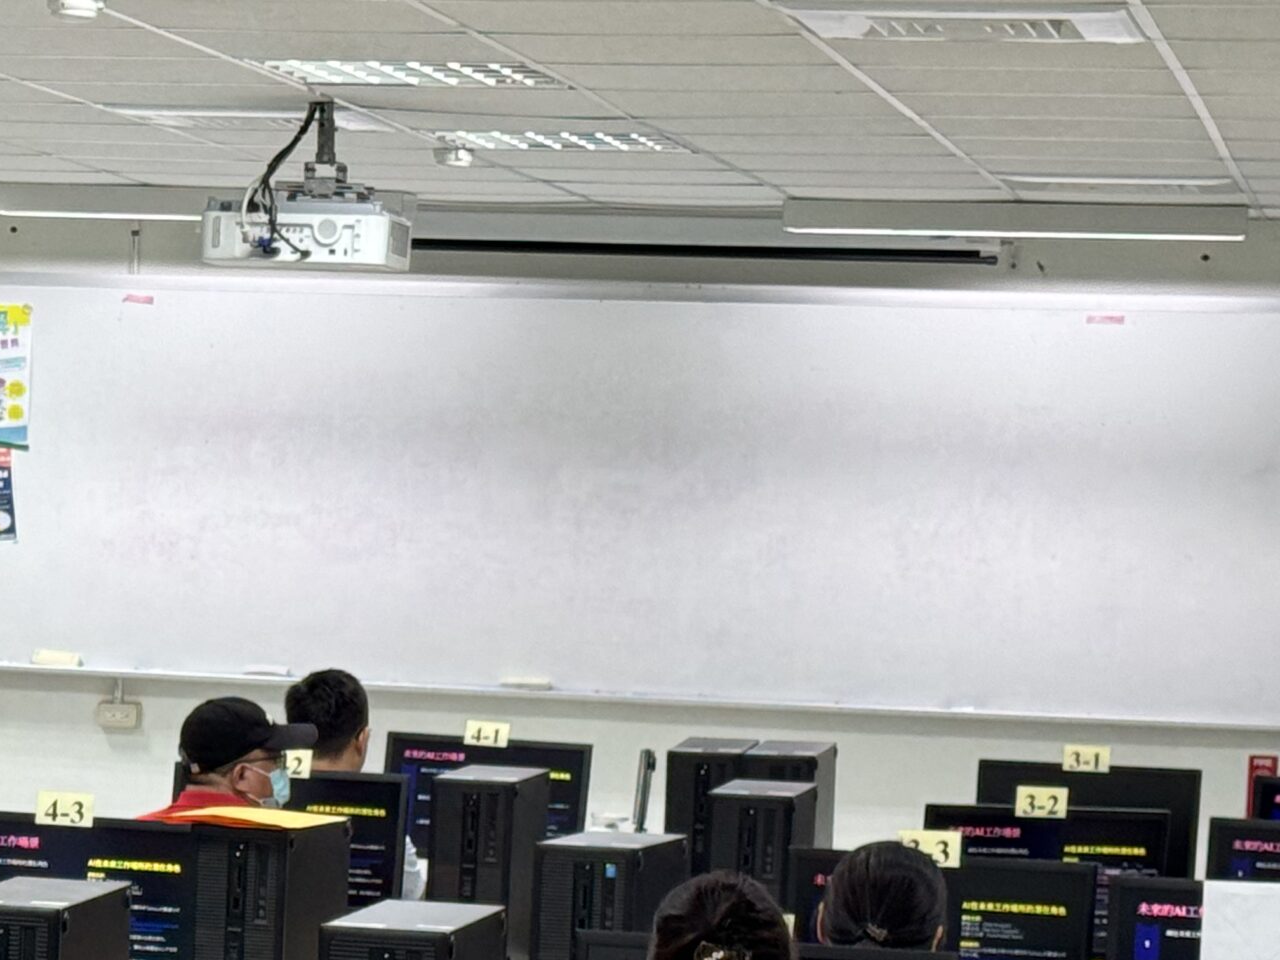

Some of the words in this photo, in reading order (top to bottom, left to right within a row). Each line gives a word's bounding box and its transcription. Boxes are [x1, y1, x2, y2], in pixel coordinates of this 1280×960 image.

[471, 727, 500, 744] 4-1
[1070, 751, 1100, 770] 3-1
[44, 799, 85, 824] 4-3
[1022, 794, 1059, 816] 3-2
